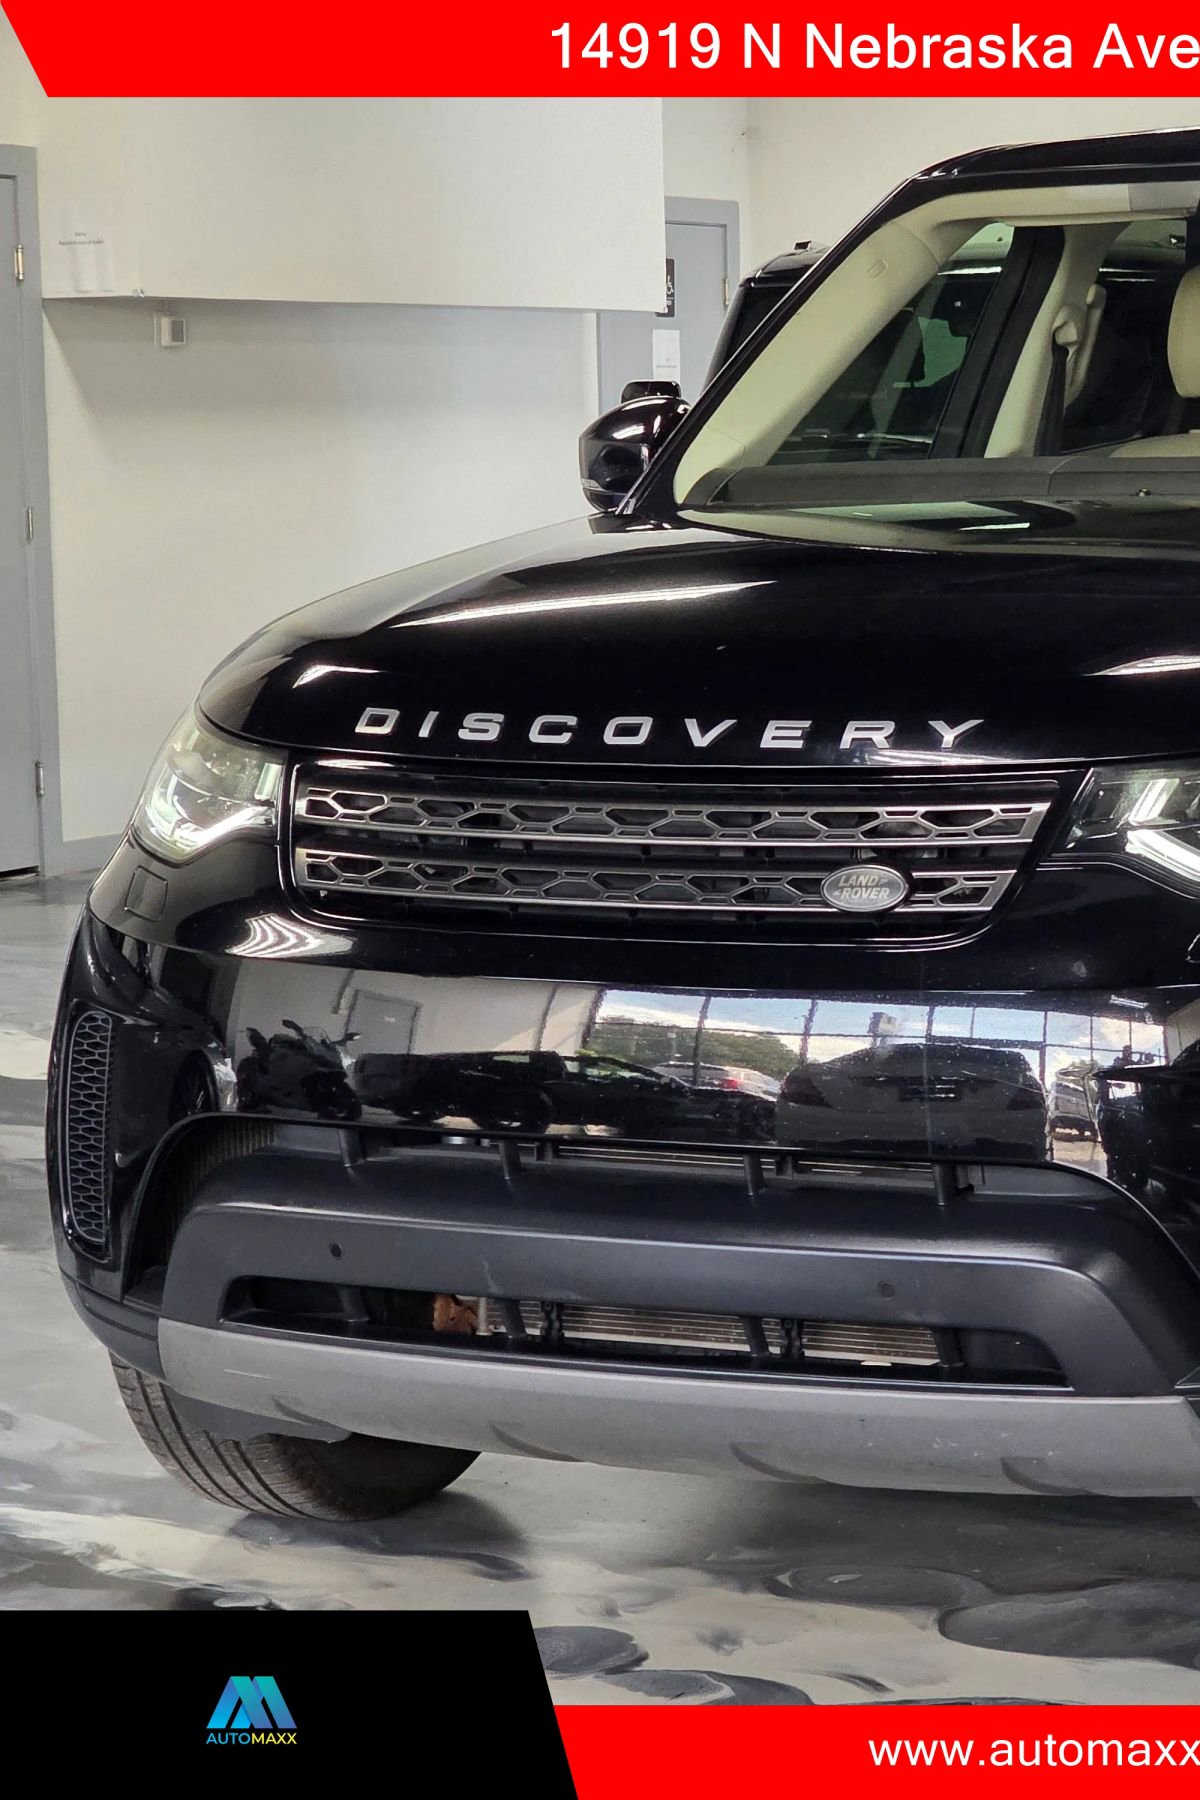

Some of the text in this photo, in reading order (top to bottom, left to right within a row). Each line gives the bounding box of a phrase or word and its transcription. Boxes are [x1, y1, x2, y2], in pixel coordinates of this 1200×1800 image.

[355, 707, 985, 750] DISCOVERY
[839, 875, 879, 887] LAND
[840, 887, 890, 899] ROVER
